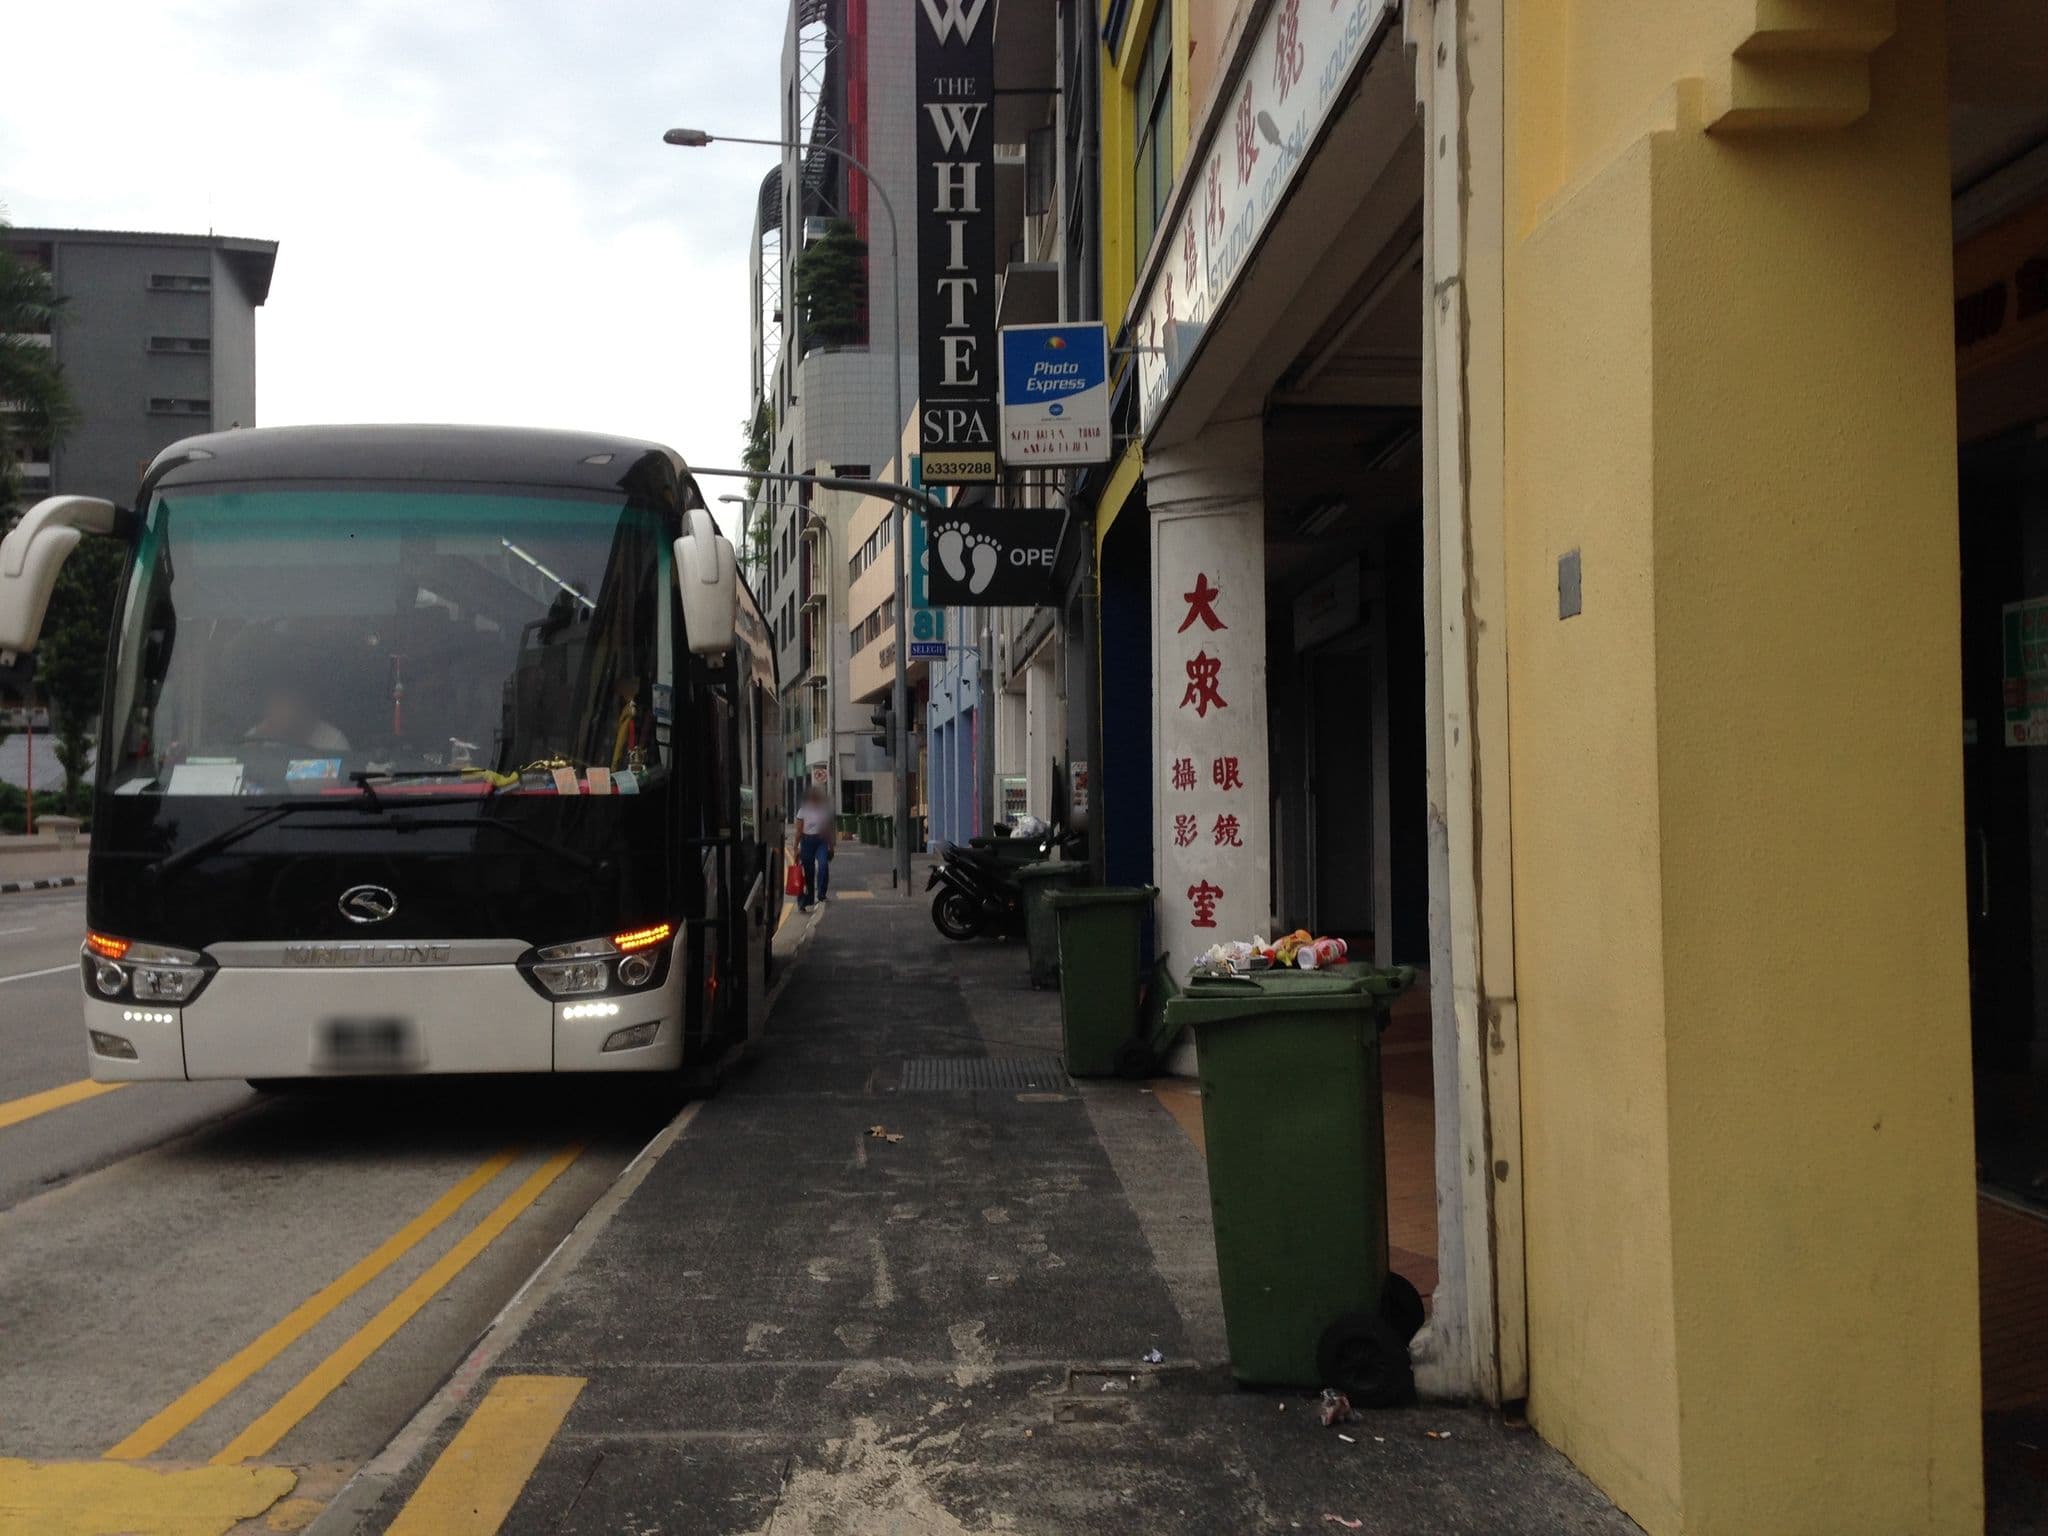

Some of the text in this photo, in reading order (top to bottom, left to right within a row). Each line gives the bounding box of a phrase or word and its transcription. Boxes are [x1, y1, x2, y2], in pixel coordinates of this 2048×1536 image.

[933, 77, 976, 96] THE
[922, 102, 988, 388] WHITE
[1210, 199, 1255, 303] STUDIO
[1033, 361, 1079, 376] Photo
[1026, 377, 1087, 394] Express
[923, 409, 993, 445] SPA
[925, 462, 992, 475] 63339288
[1009, 548, 1054, 567] OPE
[912, 610, 945, 641] 81
[365, 944, 451, 964] LONG
